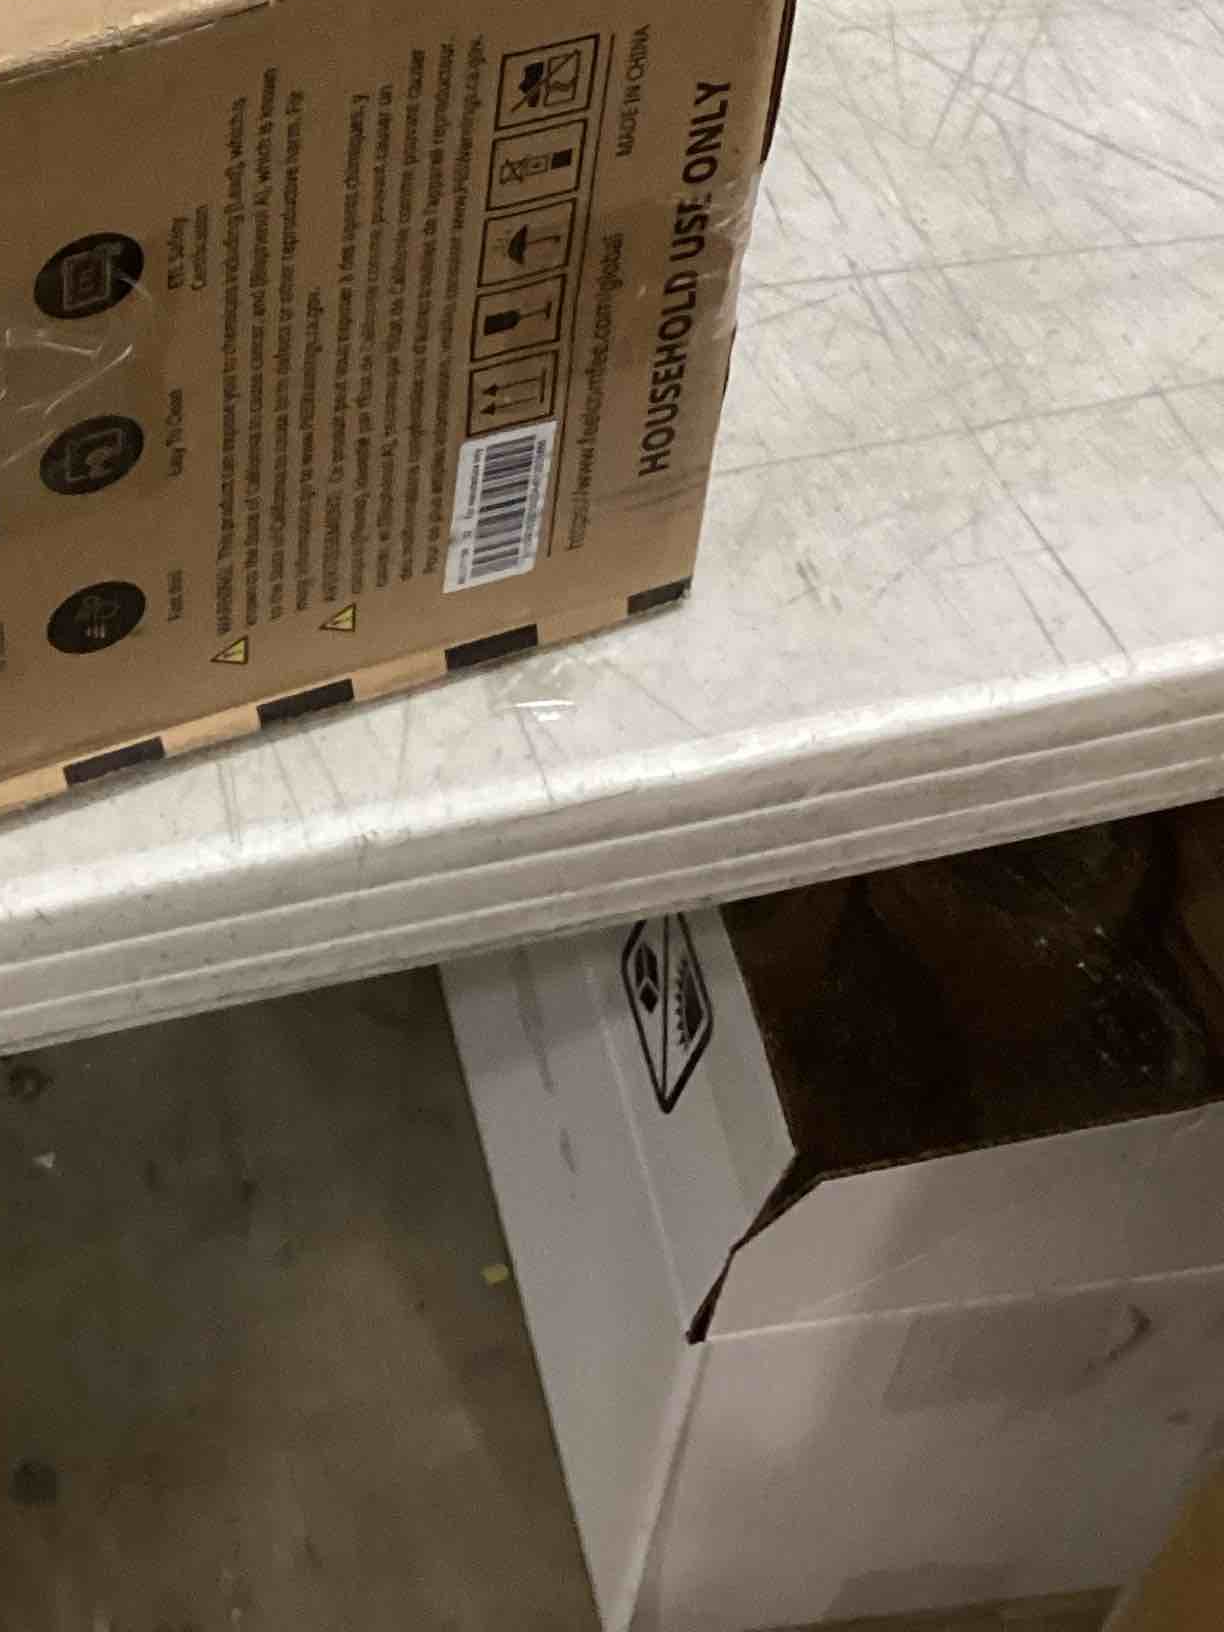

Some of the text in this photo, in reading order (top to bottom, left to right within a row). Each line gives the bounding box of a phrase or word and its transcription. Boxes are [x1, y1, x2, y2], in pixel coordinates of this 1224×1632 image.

[637, 81, 732, 478] HOUSEHOLD USE ONLY
